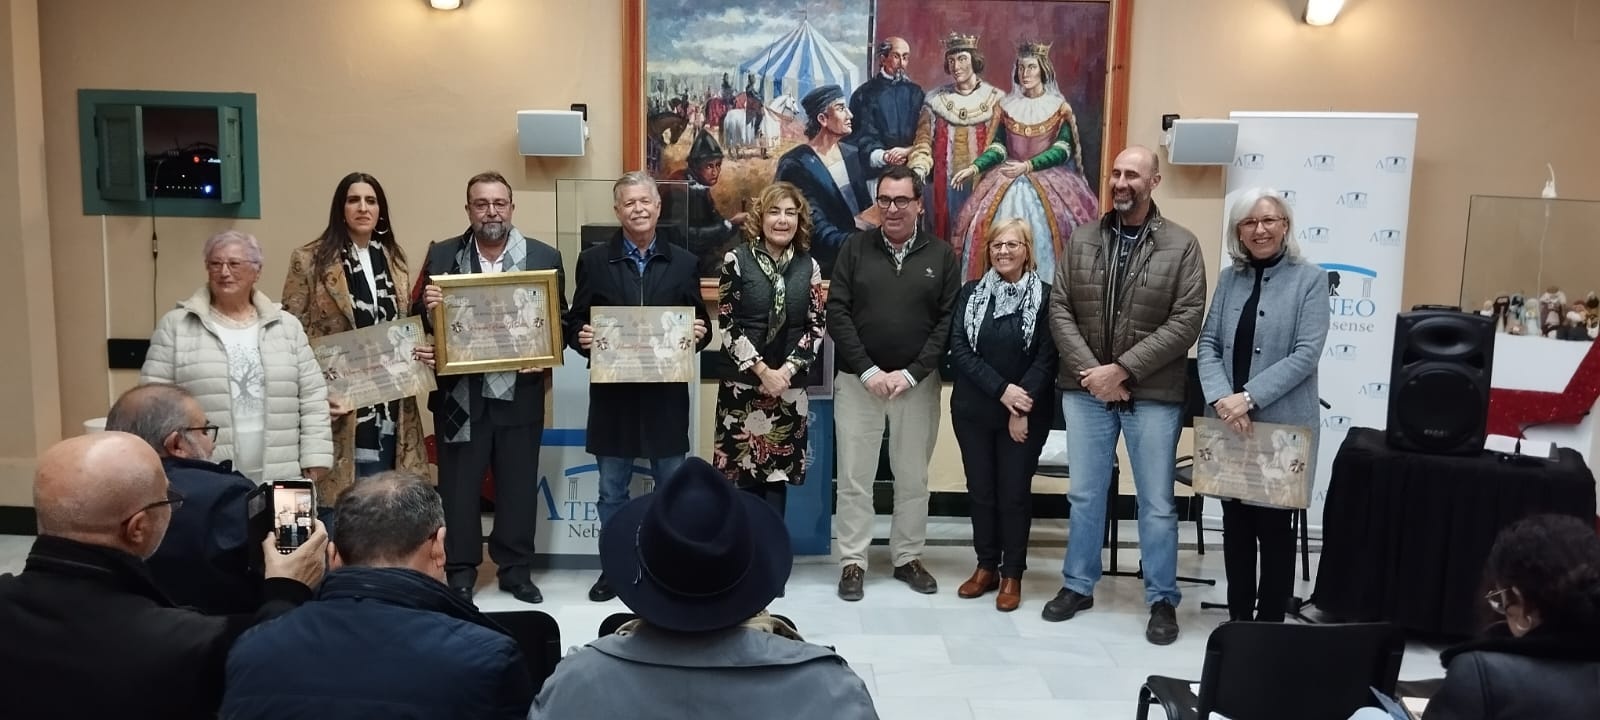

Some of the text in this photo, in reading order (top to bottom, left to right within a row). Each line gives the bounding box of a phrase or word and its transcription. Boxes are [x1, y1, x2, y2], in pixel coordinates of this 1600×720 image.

[1329, 298, 1376, 318] NEO
[1330, 321, 1375, 333] sense
[537, 475, 599, 521] ATE
[568, 523, 600, 538] Neb
